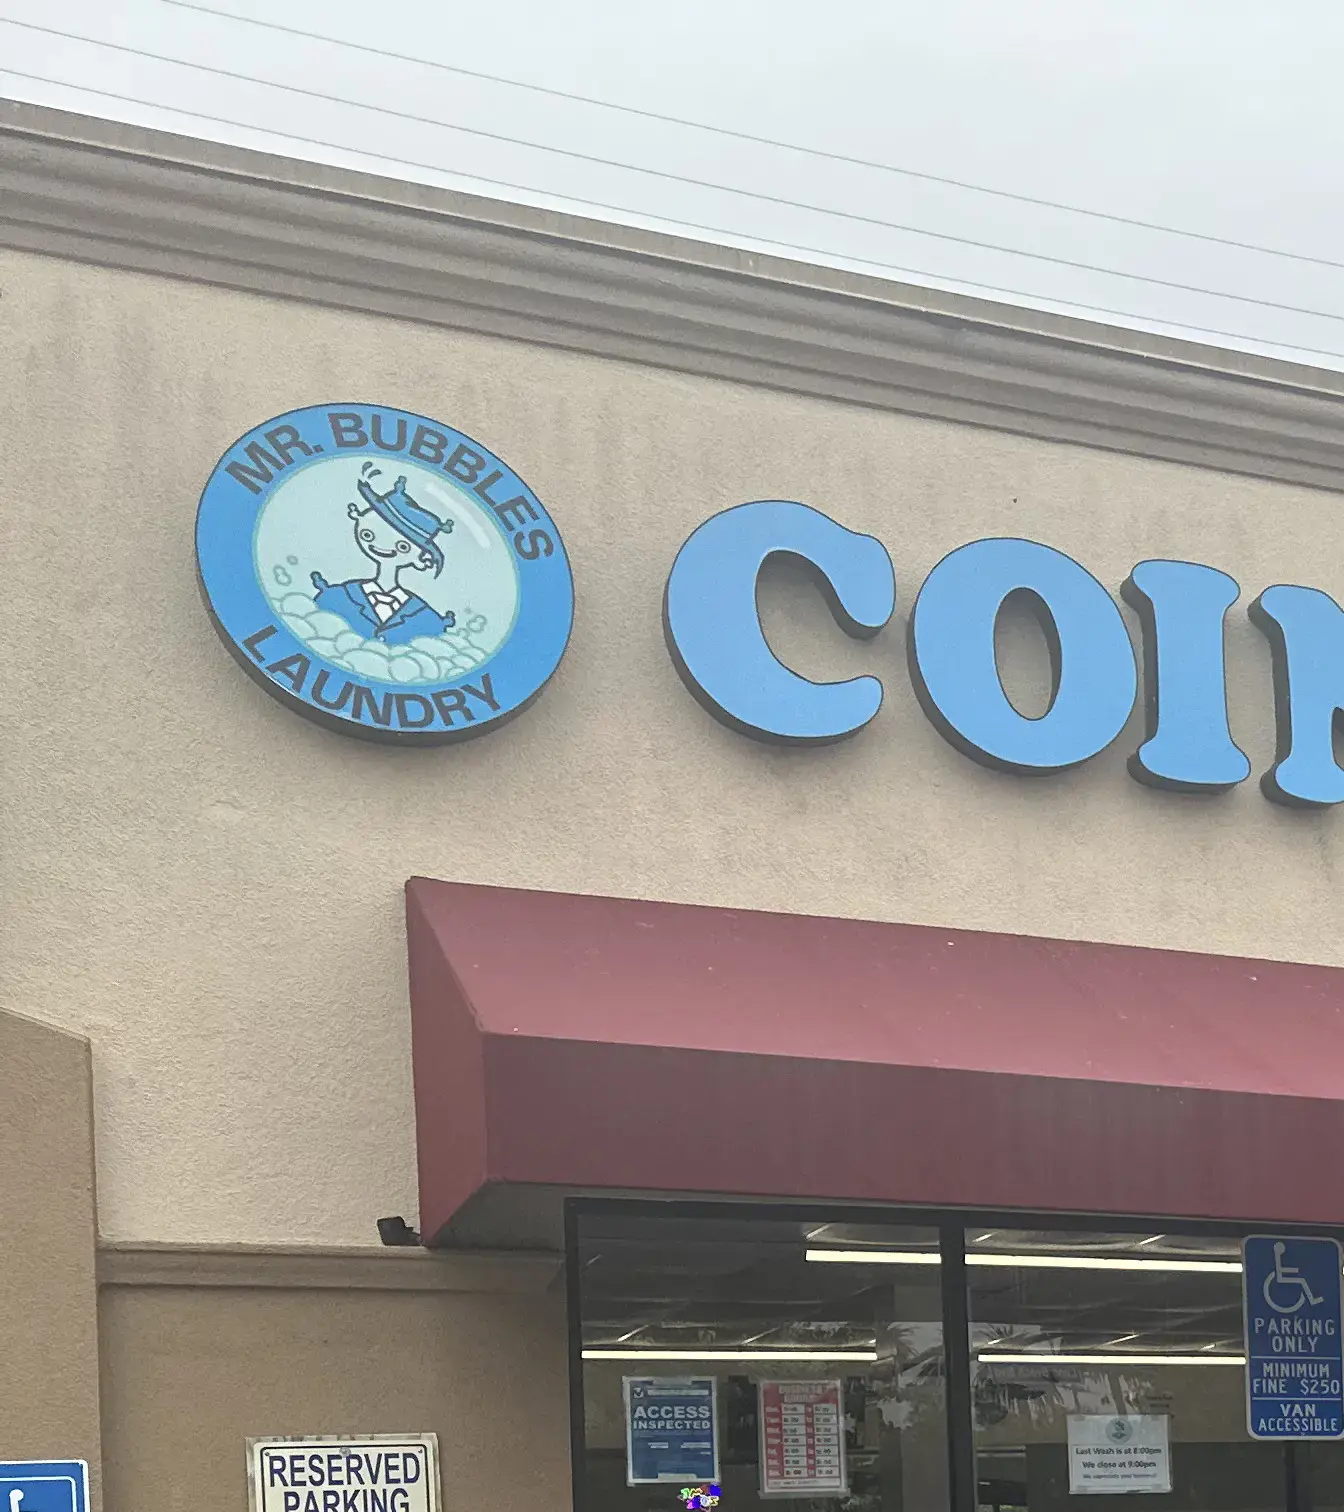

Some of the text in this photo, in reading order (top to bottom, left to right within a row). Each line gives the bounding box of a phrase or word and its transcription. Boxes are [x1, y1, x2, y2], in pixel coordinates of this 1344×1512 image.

[225, 412, 554, 561] MR. BUBBLES
[241, 624, 502, 729] LAUNDRY
[1254, 1317, 1335, 1336] PARKING
[1272, 1336, 1318, 1353] ONLY
[1263, 1362, 1330, 1378] MINIMUM
[1253, 1379, 1340, 1395] FINE $250
[634, 1405, 711, 1419] ACCESS
[1280, 1403, 1316, 1417] VAN
[633, 1420, 711, 1430] INSPECTED
[1258, 1418, 1338, 1432] ACCESSIBLE
[269, 1452, 420, 1487] RESERVED
